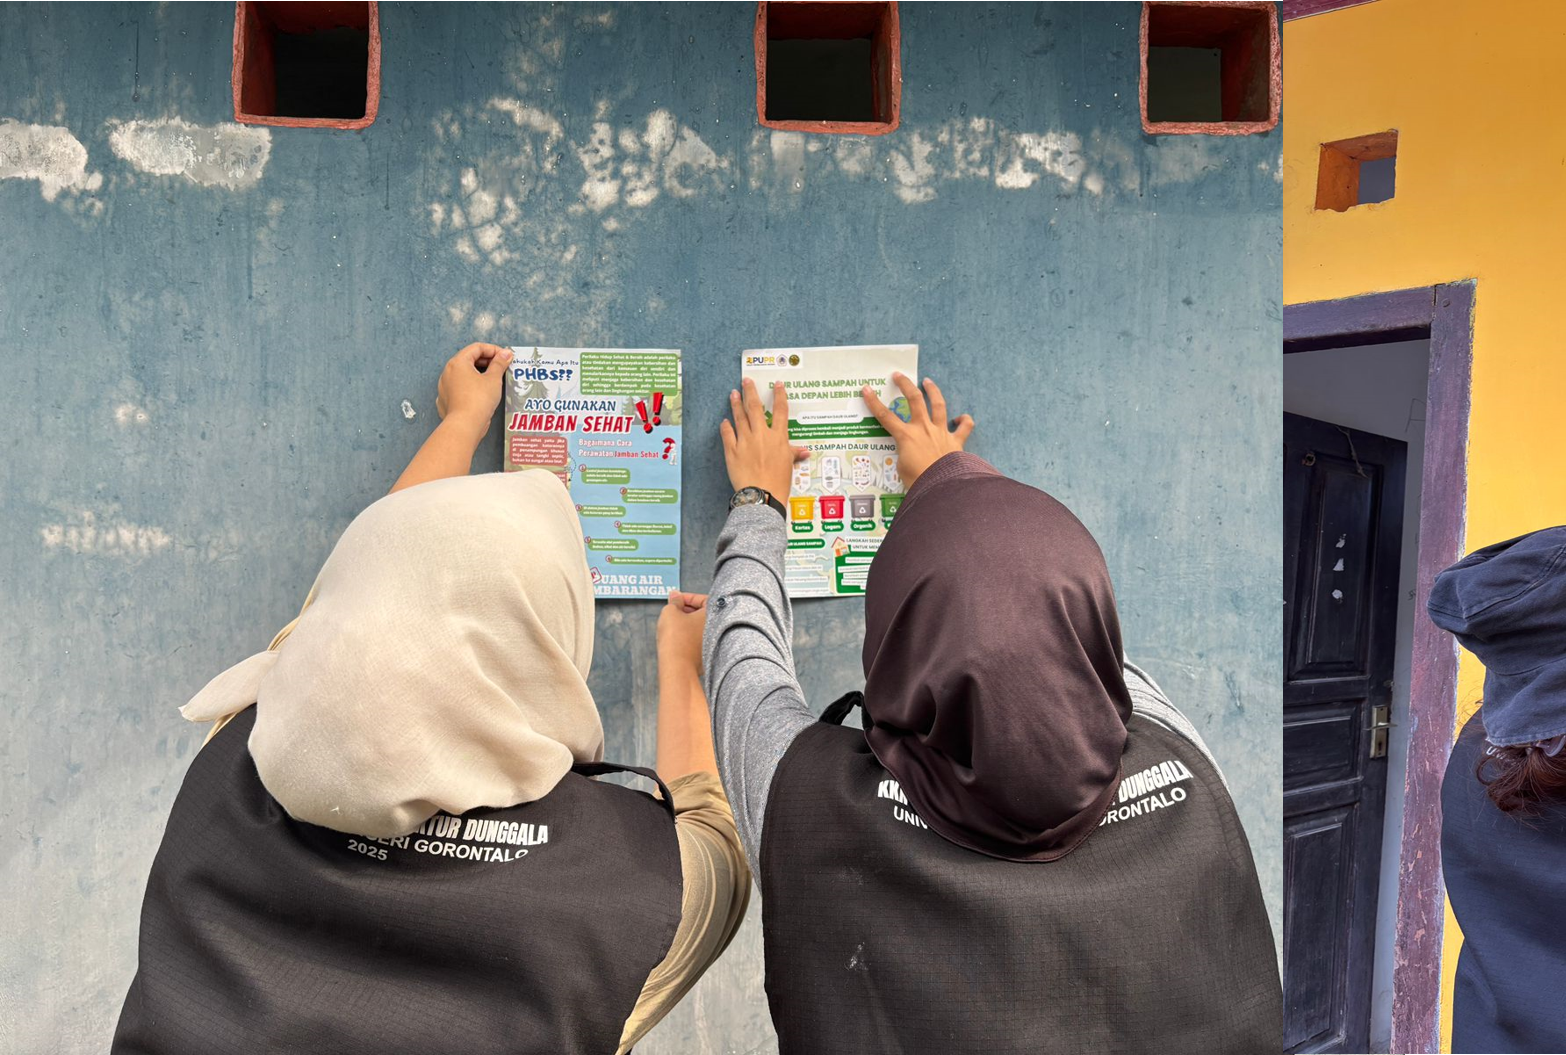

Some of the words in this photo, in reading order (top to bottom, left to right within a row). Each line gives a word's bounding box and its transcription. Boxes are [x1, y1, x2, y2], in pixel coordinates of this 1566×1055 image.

[524, 399, 551, 410] AYO
[553, 400, 616, 412] GUNAKAN
[509, 413, 577, 432] JAMBAN
[582, 415, 635, 433] SEHAT
[578, 439, 615, 447] Bagaimana
[578, 449, 614, 458] Perawatan
[640, 450, 659, 458] Sehat
[601, 575, 637, 584] UANG
[639, 575, 663, 584] AIR
[1118, 760, 1194, 803] DUNGGALA
[1099, 787, 1186, 826] RONTALO
[462, 818, 548, 846] DUNGGALA
[347, 839, 388, 861] 2025
[413, 839, 529, 862] GORONTALO
